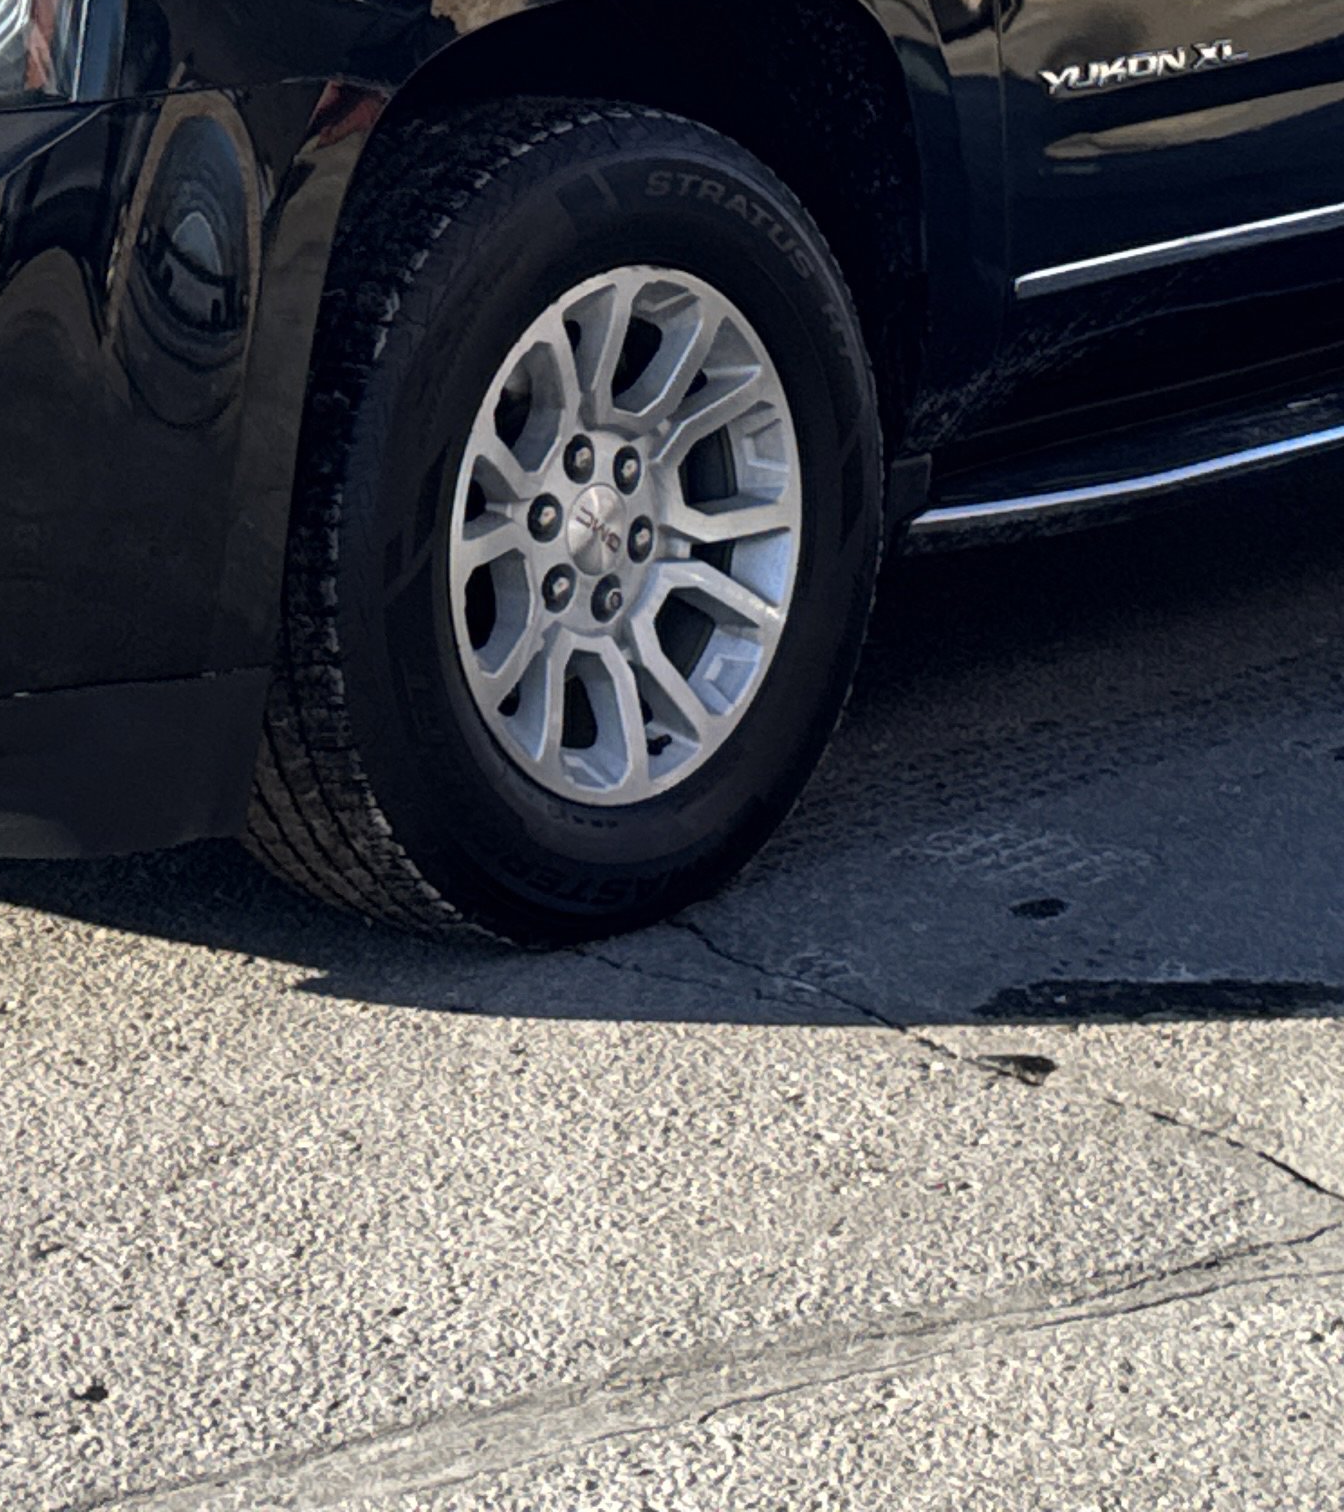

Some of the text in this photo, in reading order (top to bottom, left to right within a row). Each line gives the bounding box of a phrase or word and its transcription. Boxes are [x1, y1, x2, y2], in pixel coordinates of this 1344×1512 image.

[1037, 38, 1249, 95] YUKON XL
[644, 169, 816, 280] STRATUS
[575, 506, 622, 554] GMC
